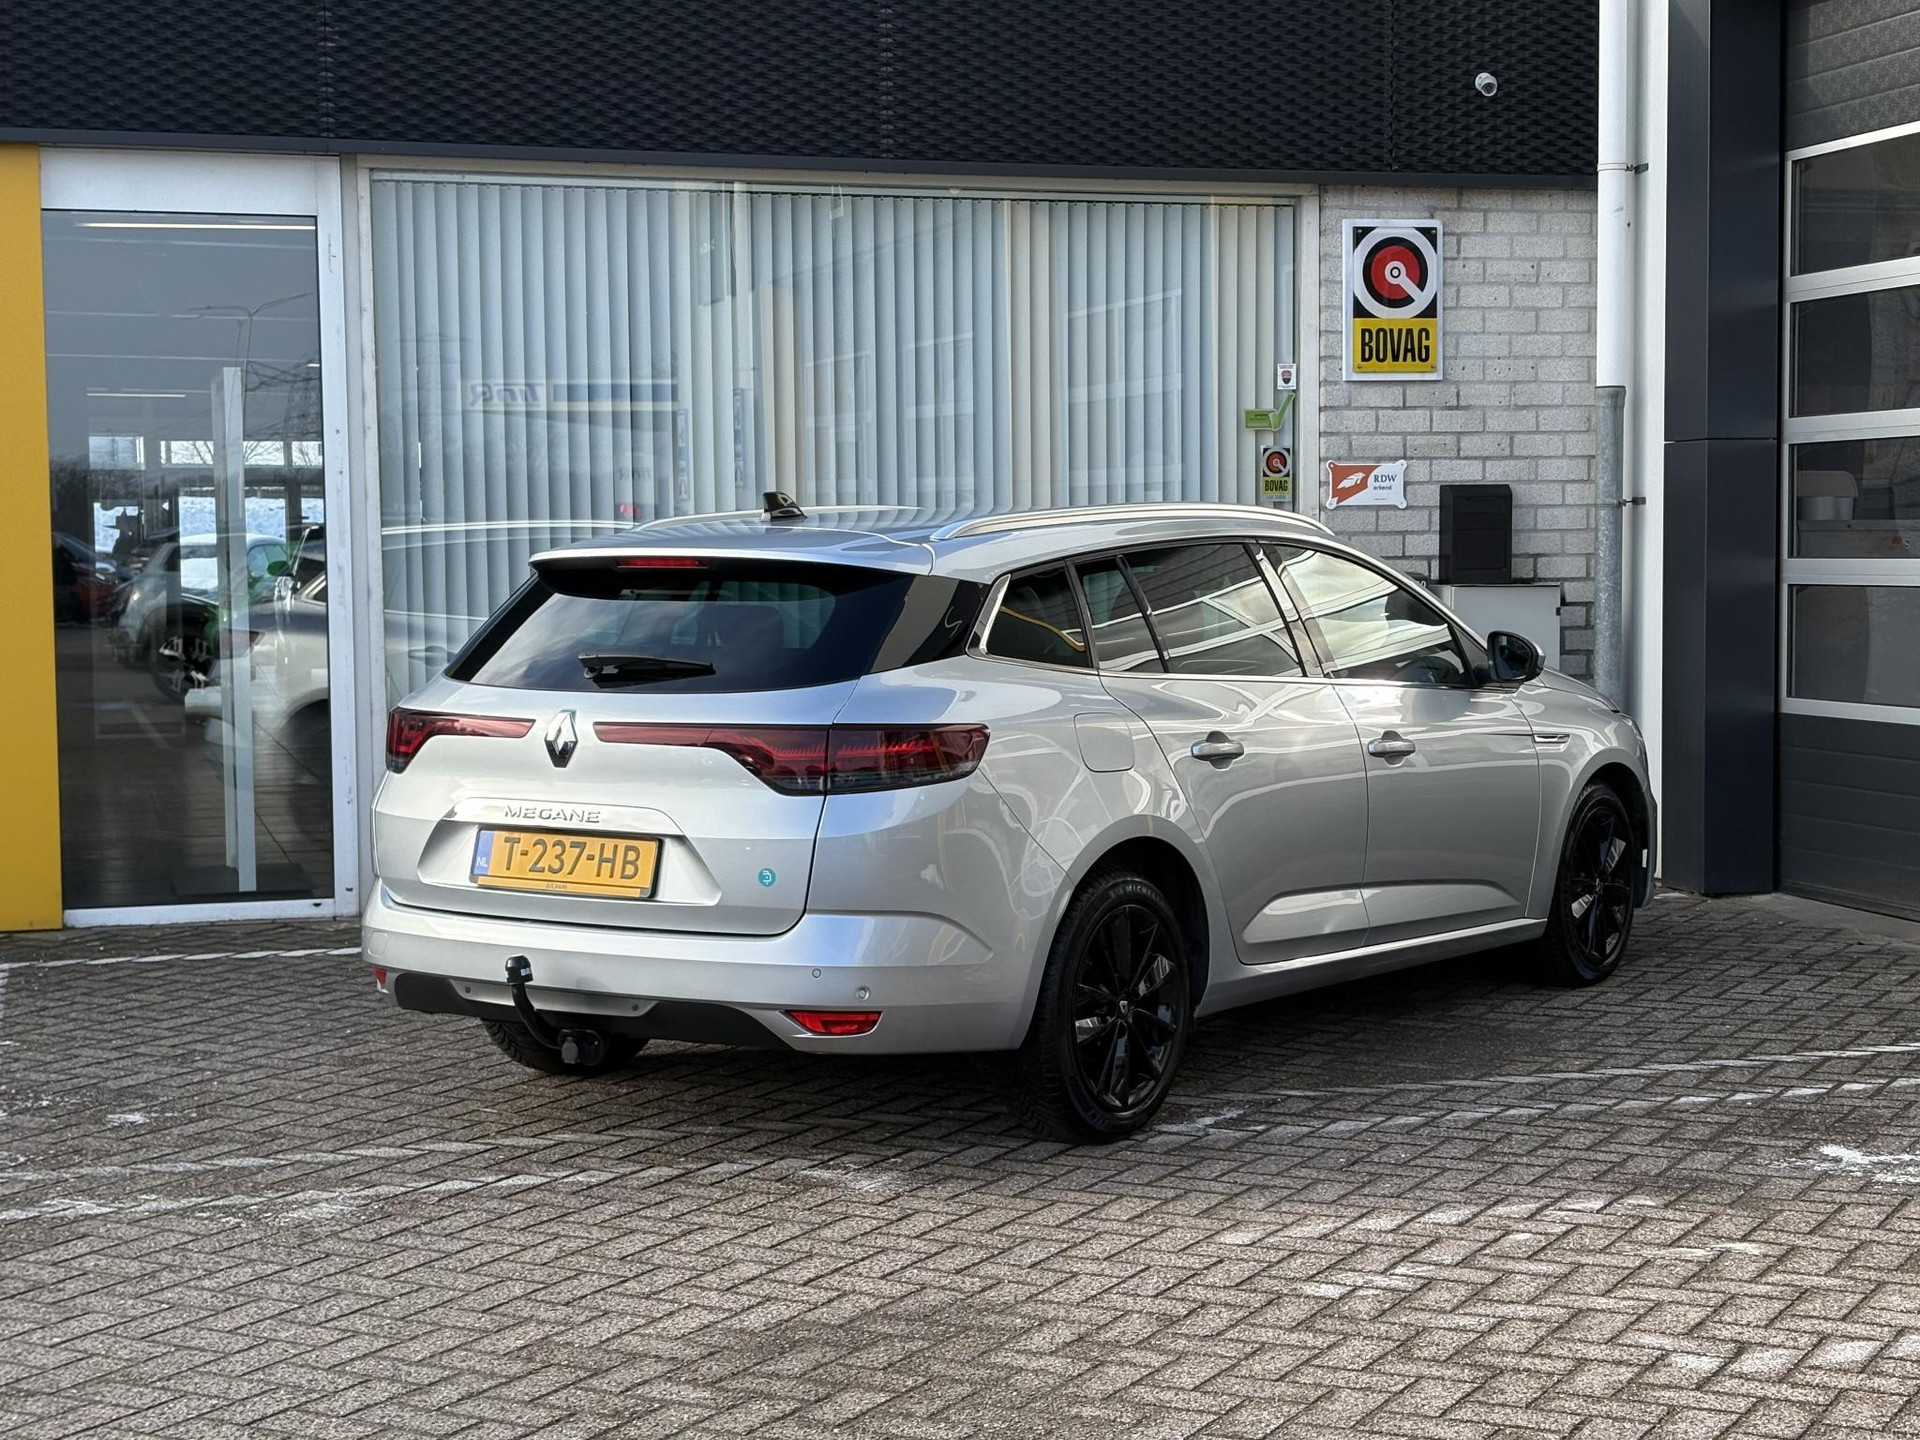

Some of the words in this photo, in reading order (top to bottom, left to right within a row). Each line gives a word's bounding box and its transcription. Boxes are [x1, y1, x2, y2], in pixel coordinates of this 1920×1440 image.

[1361, 327, 1430, 363] BOVAG
[1264, 479, 1288, 491] BOVAG
[1373, 474, 1397, 482] RDW
[504, 805, 601, 824] MEGANE
[476, 857, 488, 868] NL
[503, 836, 641, 880] T-237-HB
